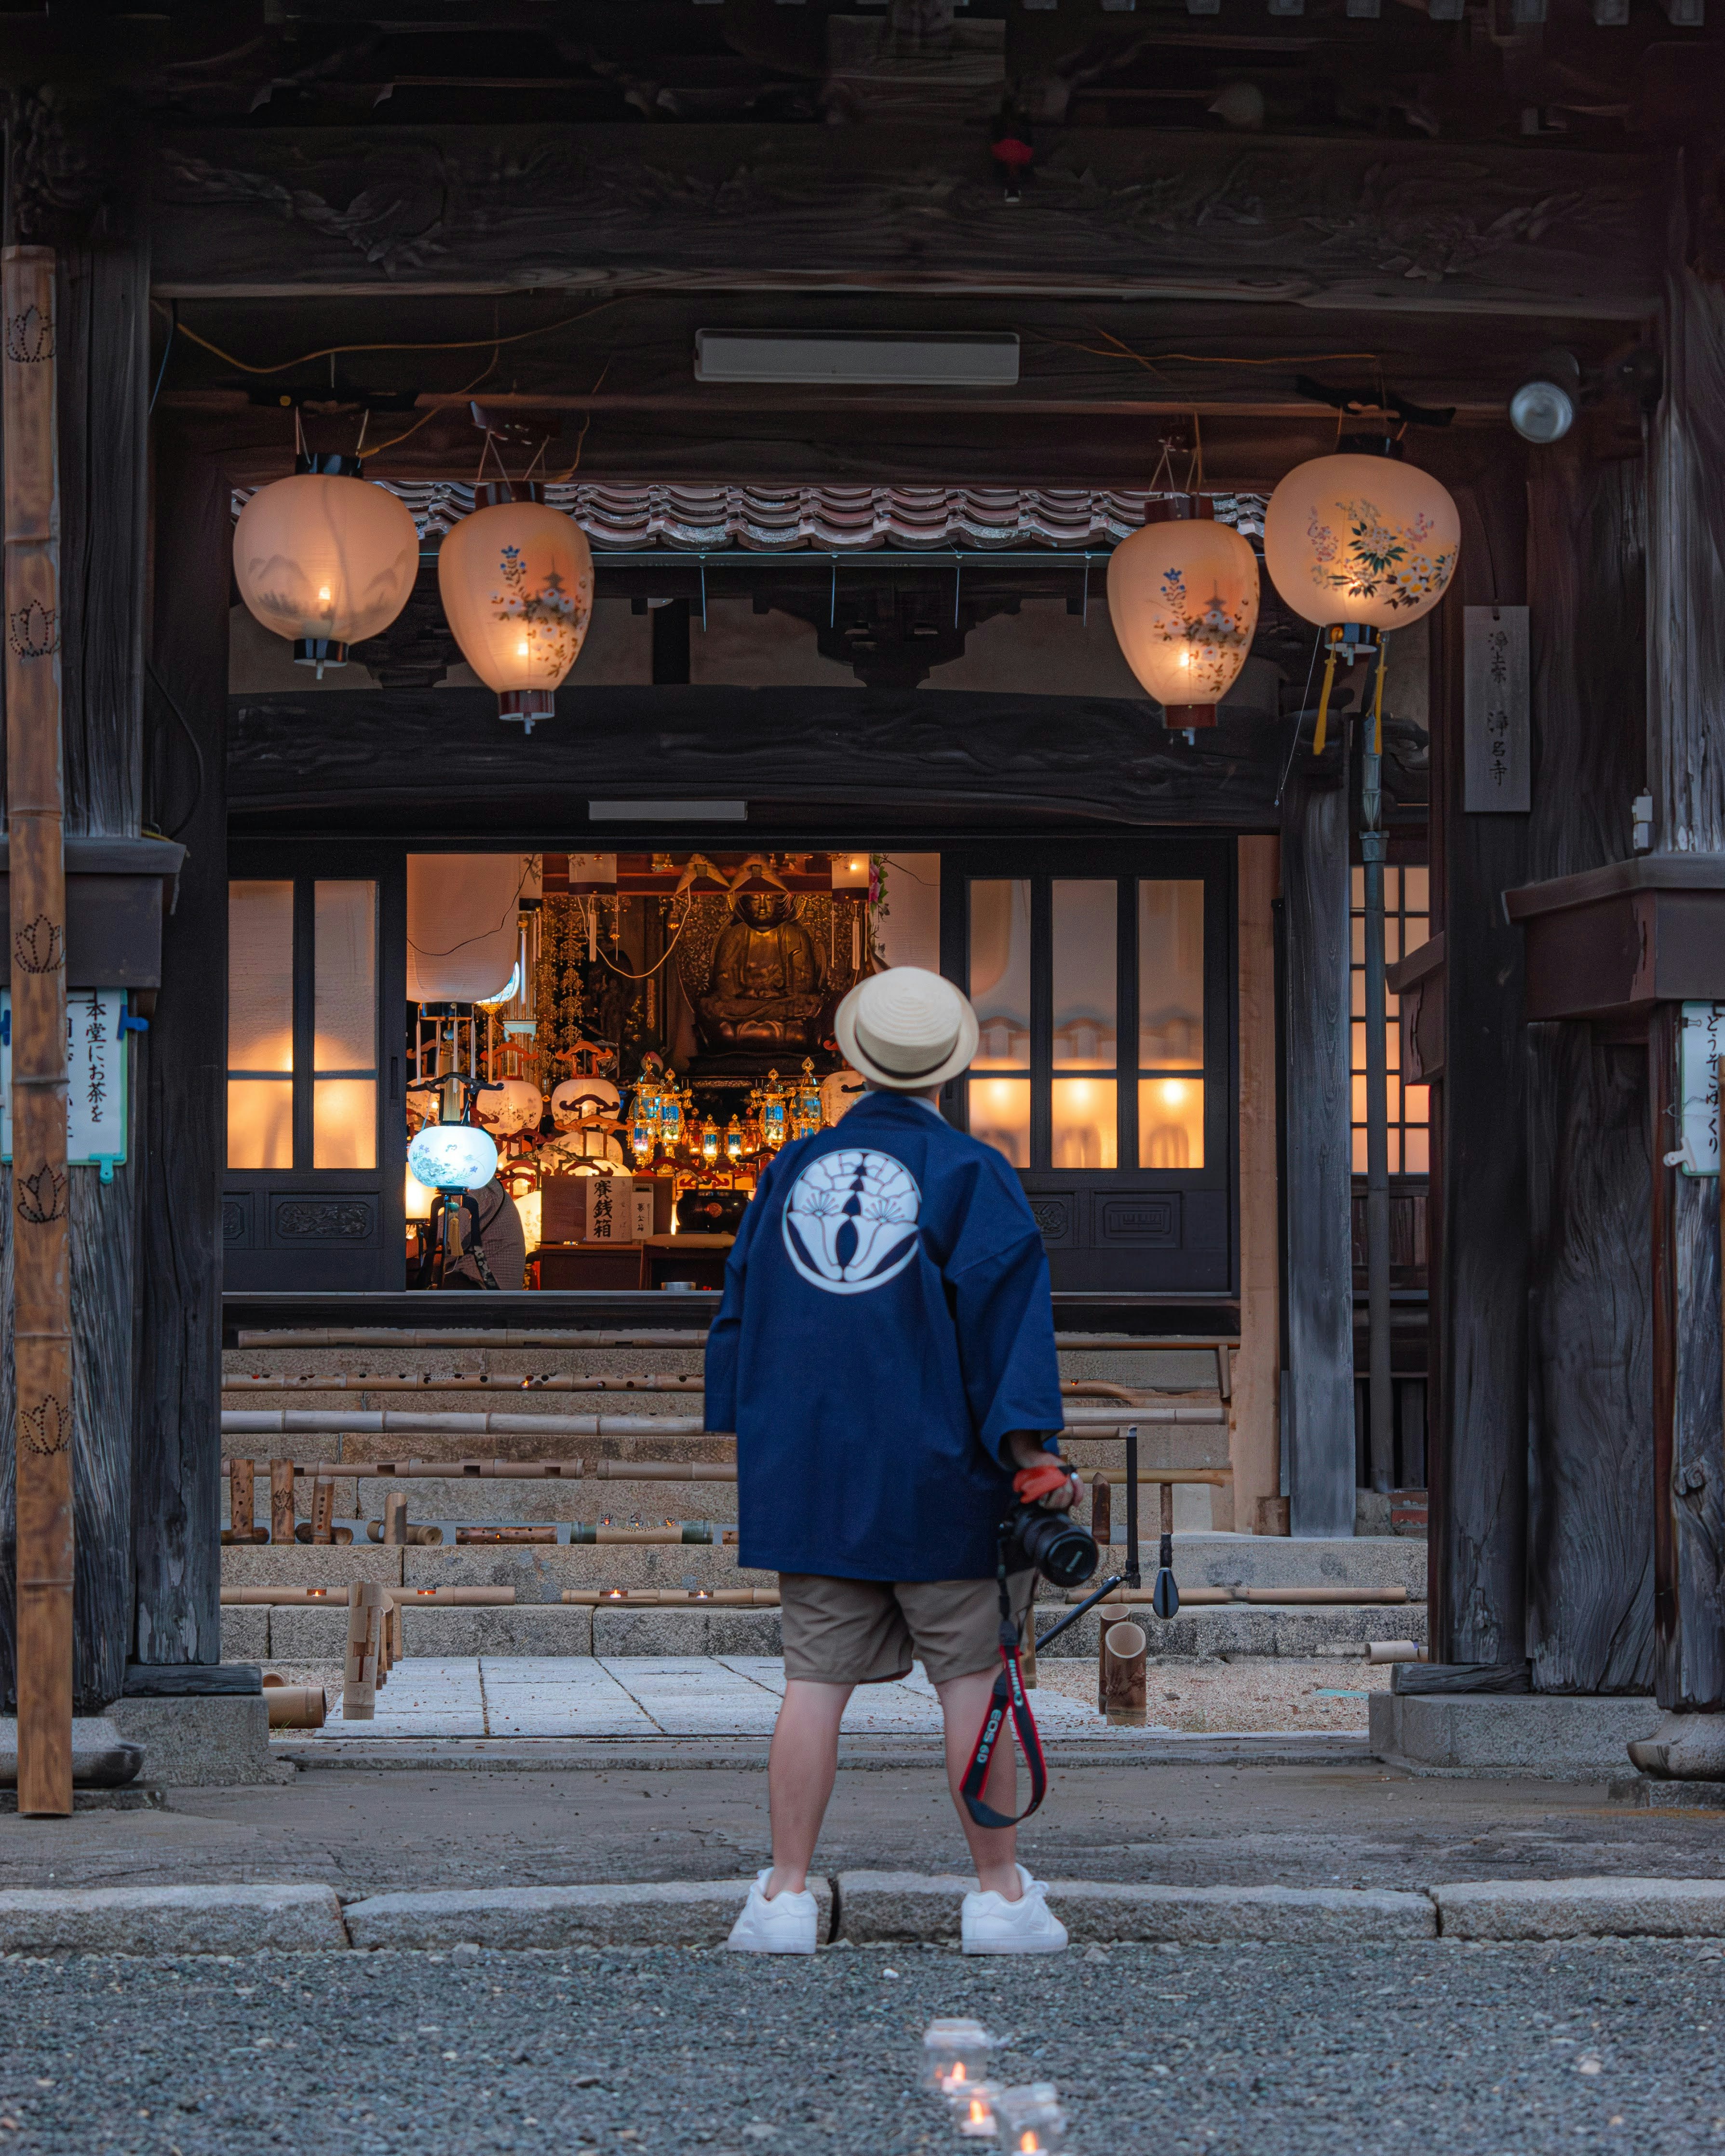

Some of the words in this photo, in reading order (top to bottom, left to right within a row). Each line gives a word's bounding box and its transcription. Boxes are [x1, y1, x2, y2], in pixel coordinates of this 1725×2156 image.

[85, 996, 107, 1123] 本堂にお茶を
[593, 1179, 613, 1238] 賽銭箱
[983, 1709, 1002, 1744] EOS
